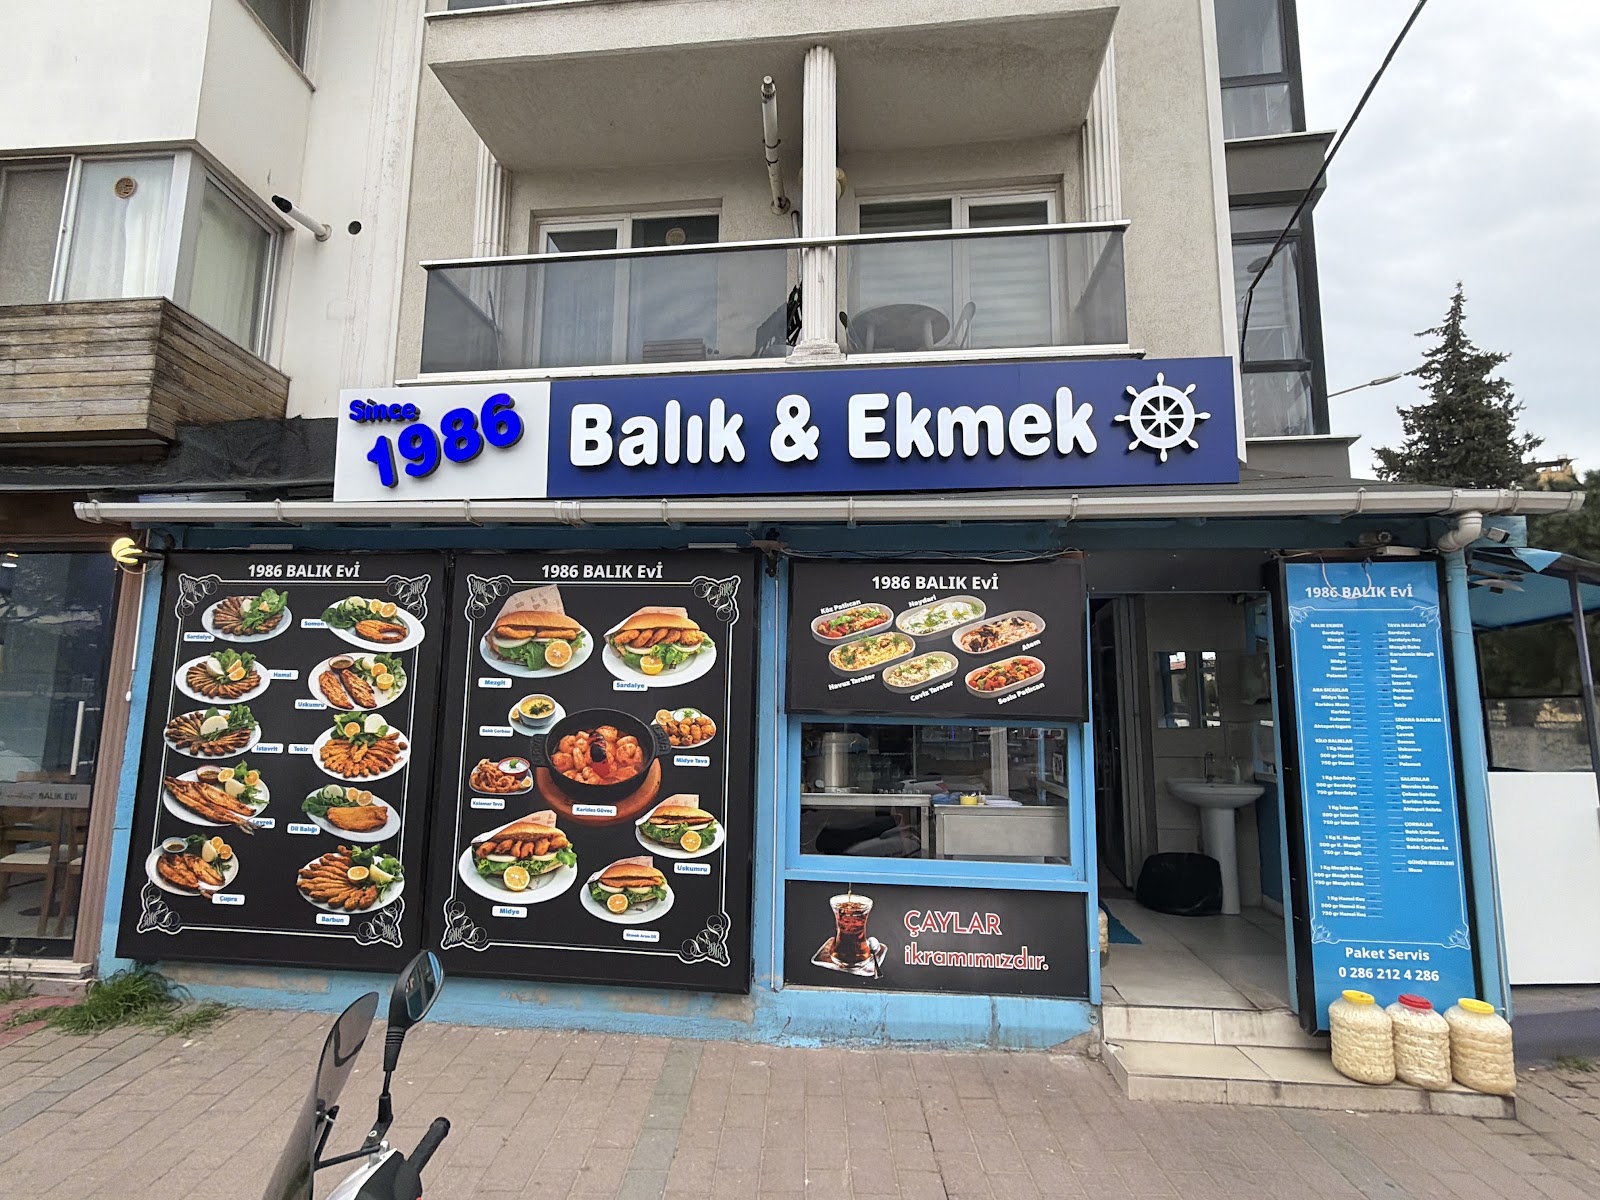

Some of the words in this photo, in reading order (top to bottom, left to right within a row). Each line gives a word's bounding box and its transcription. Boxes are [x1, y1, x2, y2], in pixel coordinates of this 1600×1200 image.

[349, 399, 418, 422] Since
[570, 397, 746, 467] Balık
[770, 394, 820, 463] &
[848, 386, 1098, 459] Ekmek
[367, 392, 525, 488] 1986
[248, 564, 282, 578] 1986
[286, 564, 333, 578] BALIK
[336, 561, 360, 578] Evİ
[542, 565, 579, 578] 1986
[583, 565, 632, 578] BALIK
[637, 561, 663, 579] Evİ
[872, 576, 911, 590] 1986
[915, 576, 967, 590] BALIK
[972, 573, 999, 590] Evİ
[1305, 587, 1338, 598] 1986
[1342, 587, 1385, 599] BALIK
[1390, 584, 1414, 598] Evİ
[820, 605, 833, 614] Köz
[834, 598, 861, 611] Patlıcan
[908, 595, 937, 608] Haydari
[1022, 639, 1041, 652] Atom
[484, 679, 506, 687] Mezgit
[850, 672, 876, 685] Tarator
[616, 682, 645, 690] Sardalye
[910, 689, 931, 702] Ceviz
[931, 680, 954, 693] Tarator
[998, 693, 1017, 705] Soslu
[1016, 681, 1045, 699] Patlıcan
[297, 701, 325, 709] Uskumru
[676, 757, 694, 765] Midye
[596, 807, 613, 815] Güveç
[300, 826, 318, 834] Balığı
[677, 865, 708, 873] Uskumru
[499, 907, 520, 916] Midye
[321, 916, 344, 924] Barbun
[904, 910, 1002, 937] ÇAYLAR
[904, 943, 1049, 971] ikramımızdır.
[1346, 947, 1385, 960] Paket
[1388, 948, 1430, 961] Servis
[1339, 967, 1347, 978] 0
[1350, 968, 1374, 979] 286
[1377, 968, 1401, 980] 212
[1404, 970, 1412, 980] 4
[1415, 970, 1440, 981] 286
